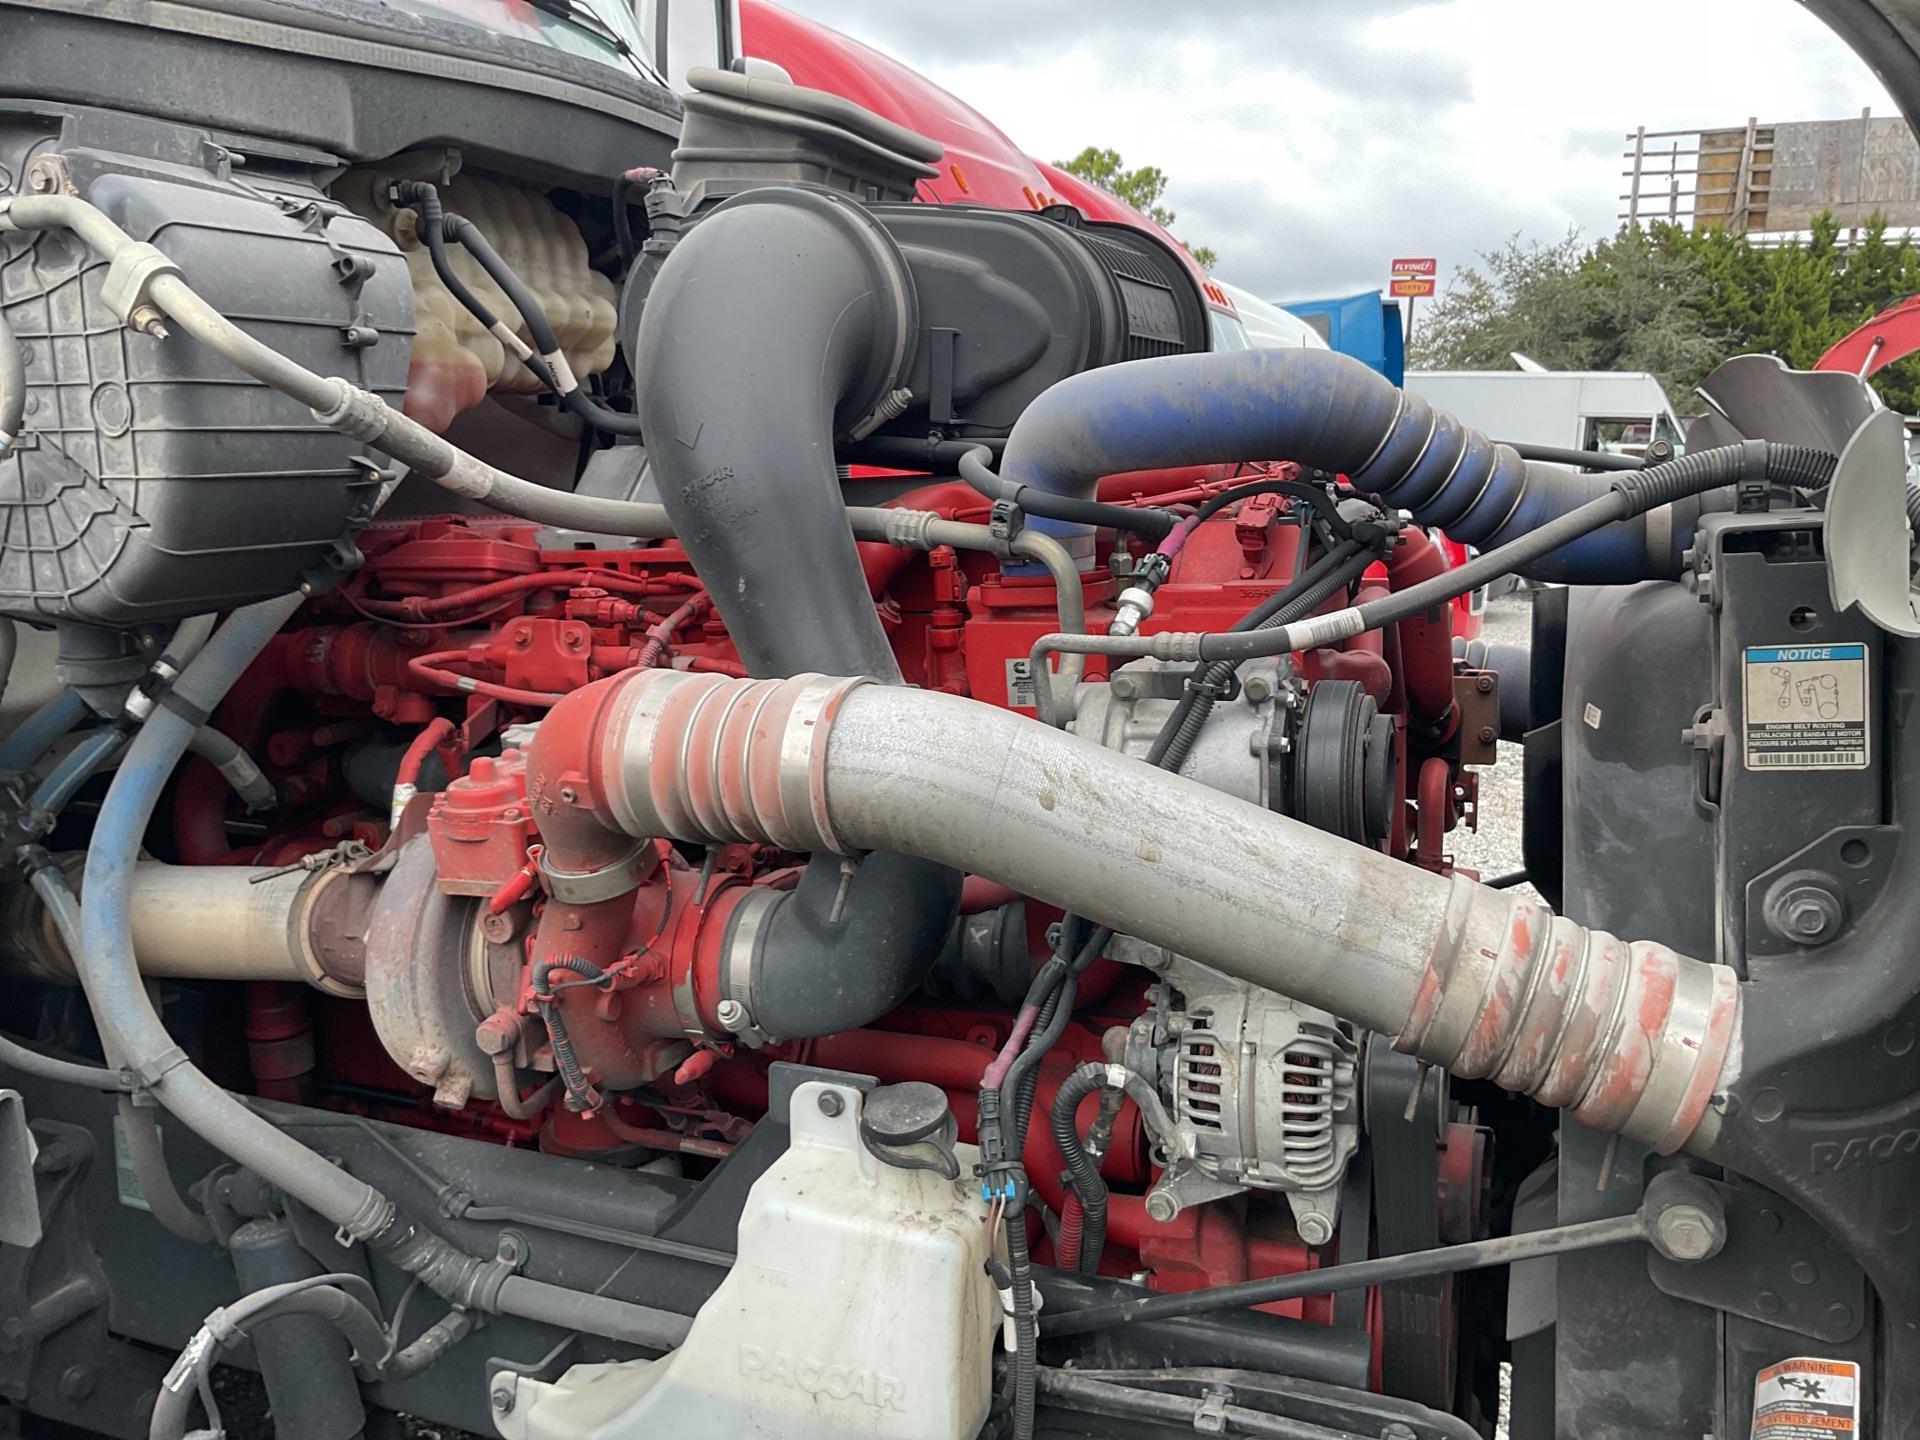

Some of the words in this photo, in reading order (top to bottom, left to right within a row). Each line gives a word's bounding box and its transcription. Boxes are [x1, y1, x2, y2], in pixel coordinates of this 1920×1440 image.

[1777, 648, 1831, 661] NOTICE
[1783, 1361, 1834, 1373] WARNING
[738, 1341, 907, 1413] PACCAR
[1767, 1413, 1851, 1429] AVERTISSEMENT
